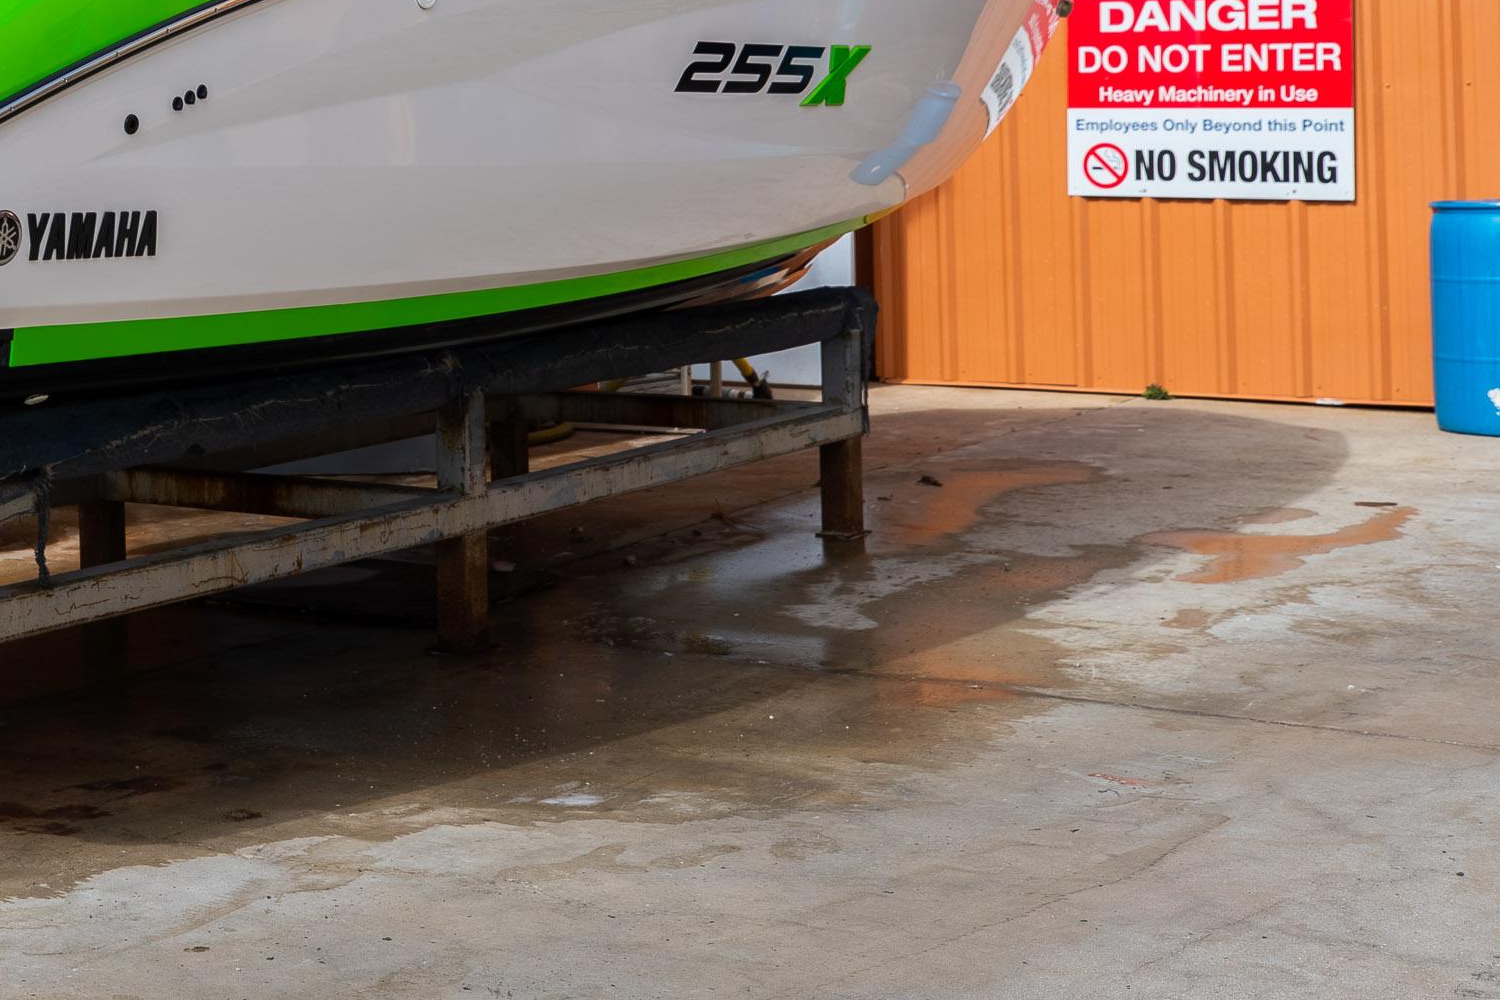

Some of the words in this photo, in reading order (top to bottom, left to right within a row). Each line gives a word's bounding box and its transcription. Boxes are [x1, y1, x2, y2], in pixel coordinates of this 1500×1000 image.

[674, 41, 872, 107] 255X
[1078, 45, 1128, 74] DO
[1138, 44, 1211, 73] NOT
[1221, 43, 1342, 72] ENTER
[1099, 86, 1154, 106] Heavy
[1158, 85, 1253, 106] Machinery
[1258, 85, 1275, 102] in
[1280, 85, 1318, 102] Use
[1076, 118, 1158, 134] Employees
[1163, 118, 1197, 134] Only
[1202, 118, 1262, 134] Beyond
[1267, 118, 1297, 132] this
[1302, 118, 1345, 132] Point
[1134, 149, 1177, 182] NO
[1187, 149, 1338, 184] SMOKING
[27, 210, 158, 261] YAMAHA
